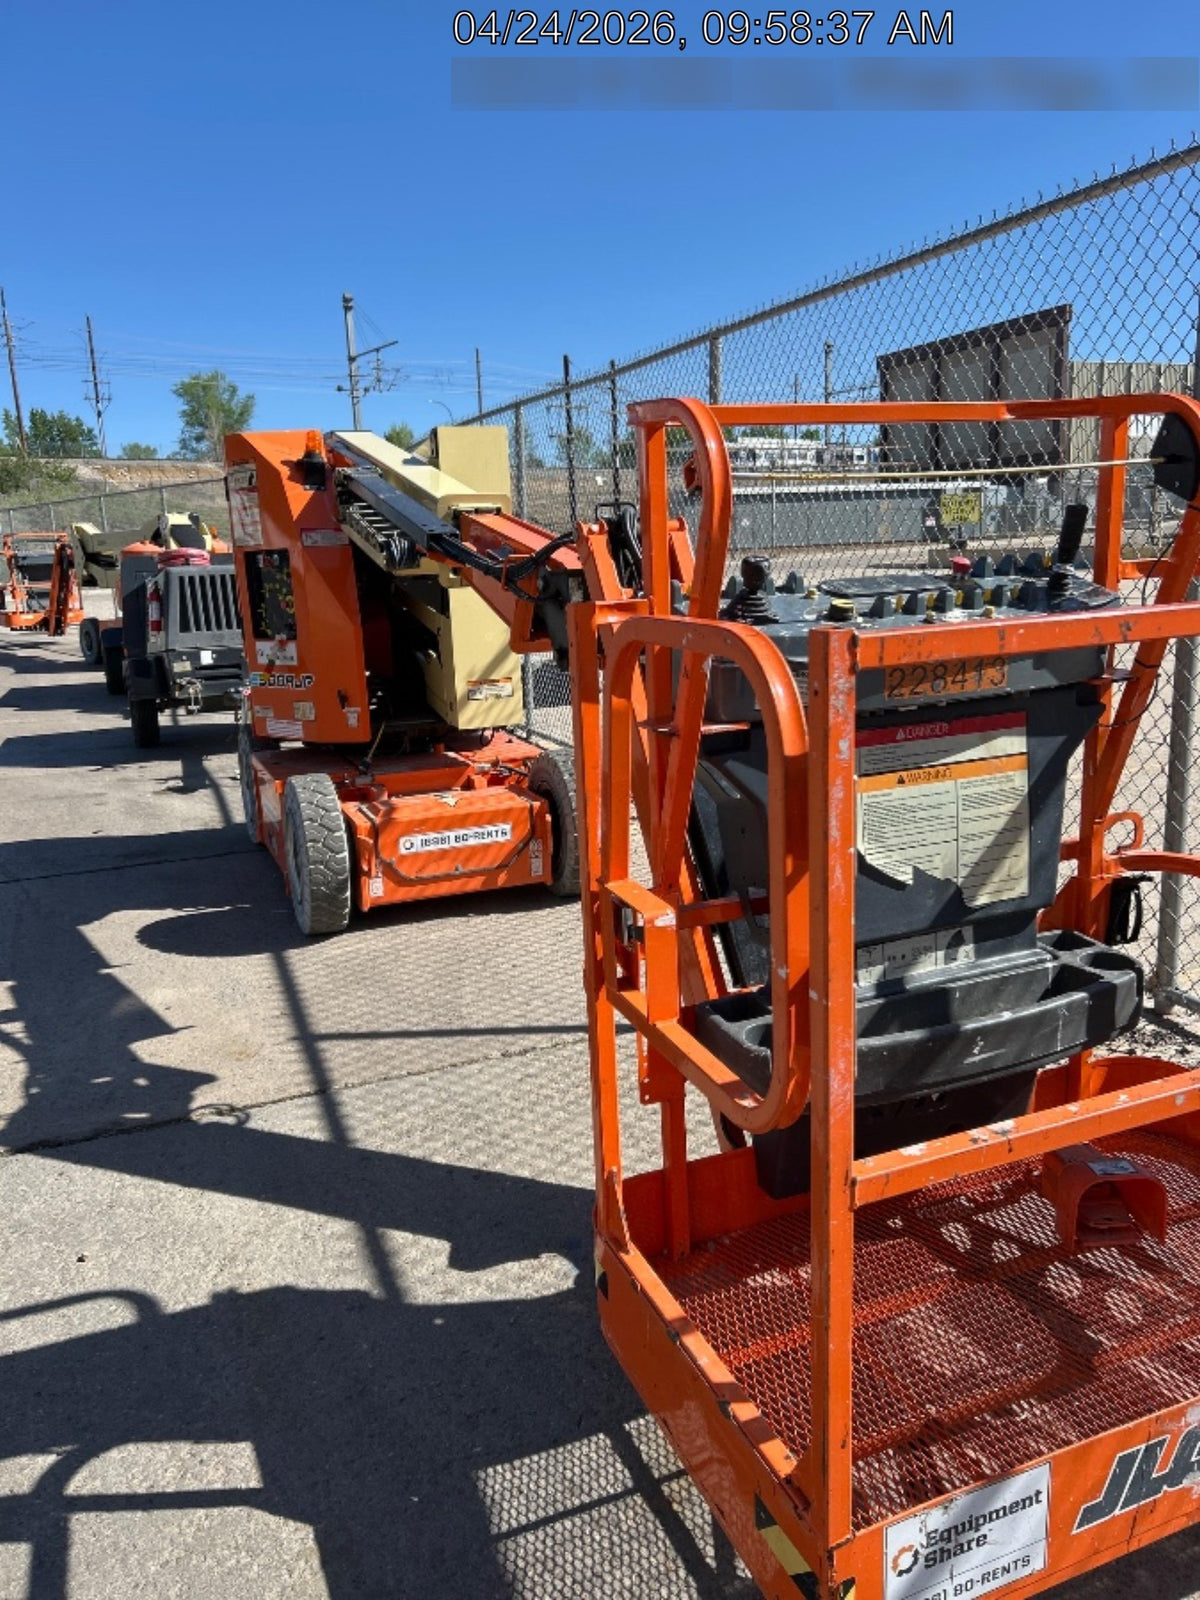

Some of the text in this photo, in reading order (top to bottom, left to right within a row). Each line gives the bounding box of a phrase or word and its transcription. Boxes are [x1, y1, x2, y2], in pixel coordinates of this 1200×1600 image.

[888, 657, 1006, 698] 228413
[926, 1489, 1043, 1549] Equipment
[923, 1533, 988, 1569] Share
[953, 1554, 1031, 1598] 80-RENTS
